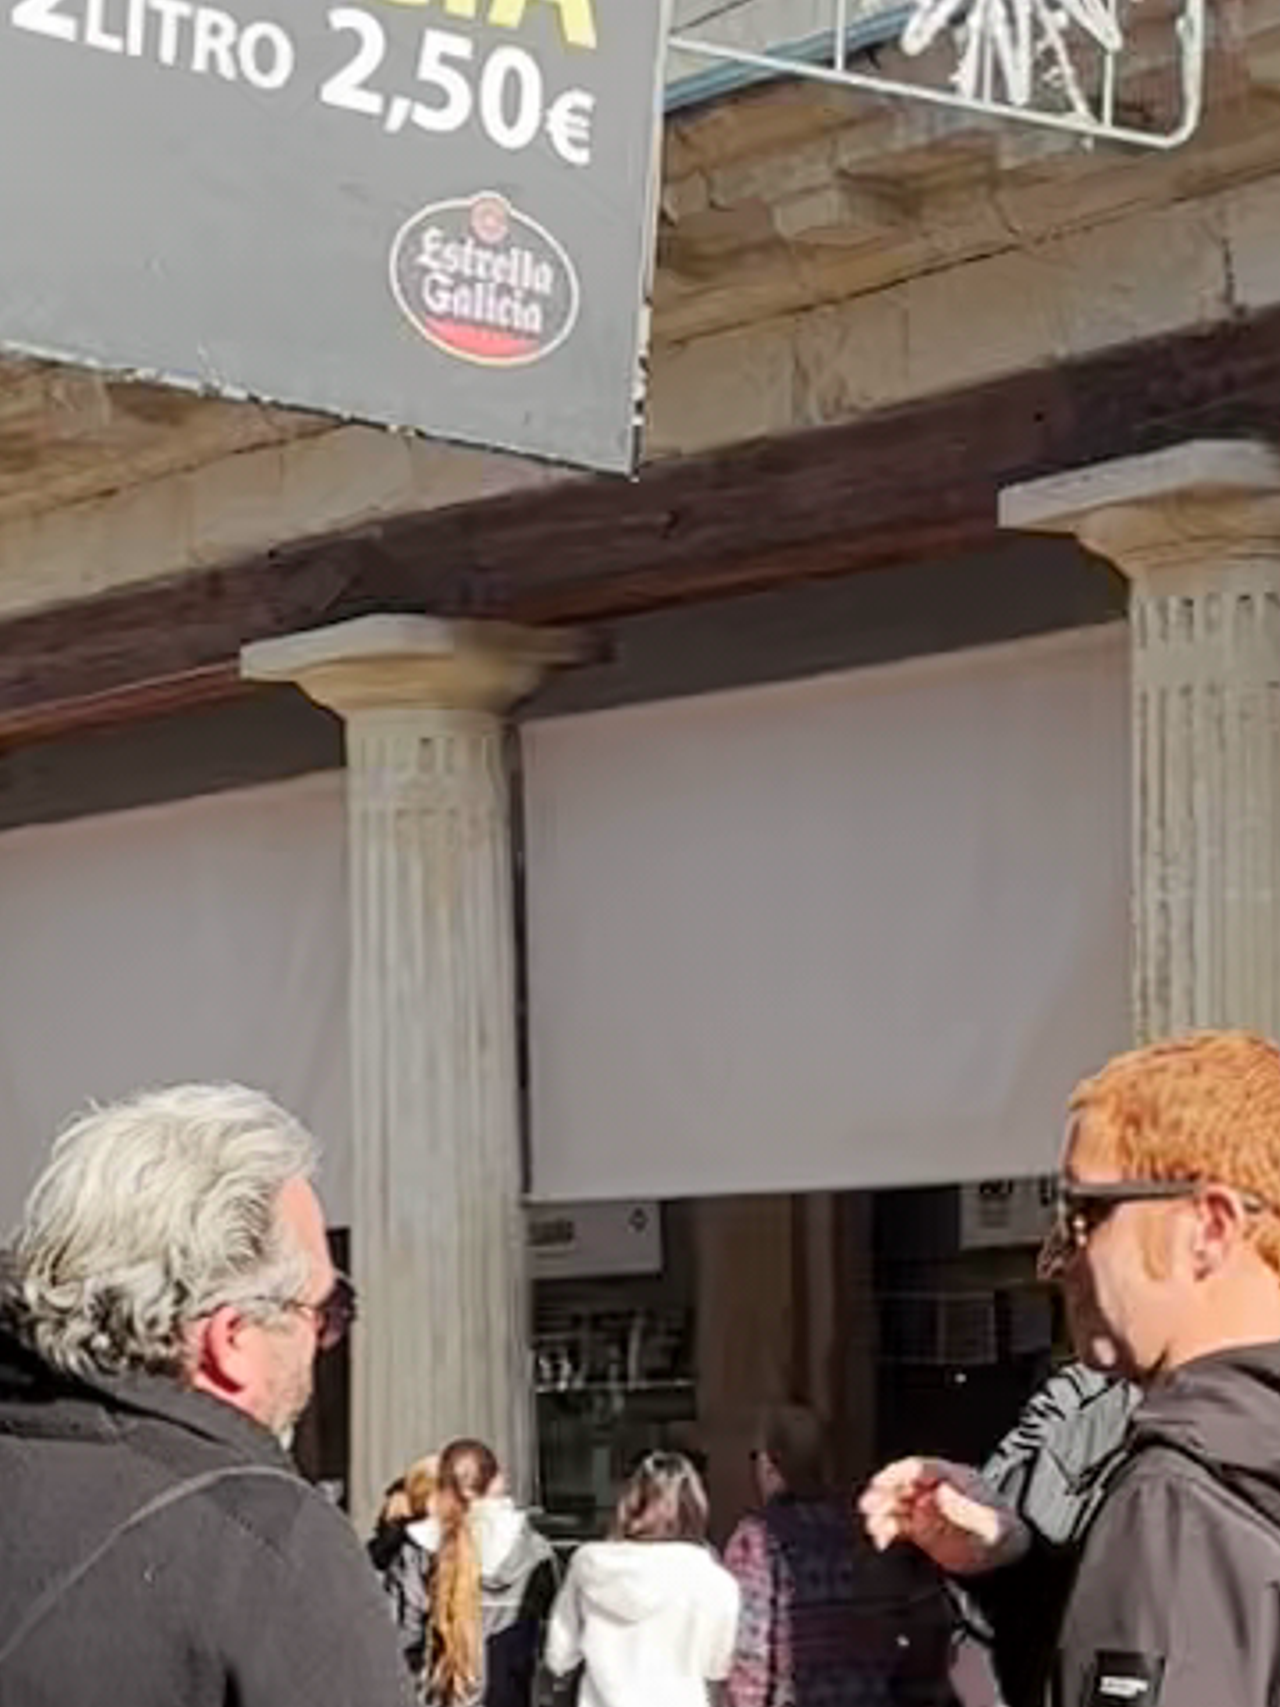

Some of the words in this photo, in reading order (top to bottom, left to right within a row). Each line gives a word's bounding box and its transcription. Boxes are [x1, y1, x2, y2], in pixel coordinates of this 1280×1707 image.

[320, 7, 596, 165] 2,50€
[417, 225, 555, 296] Estrella
[423, 271, 544, 334] Galicia
